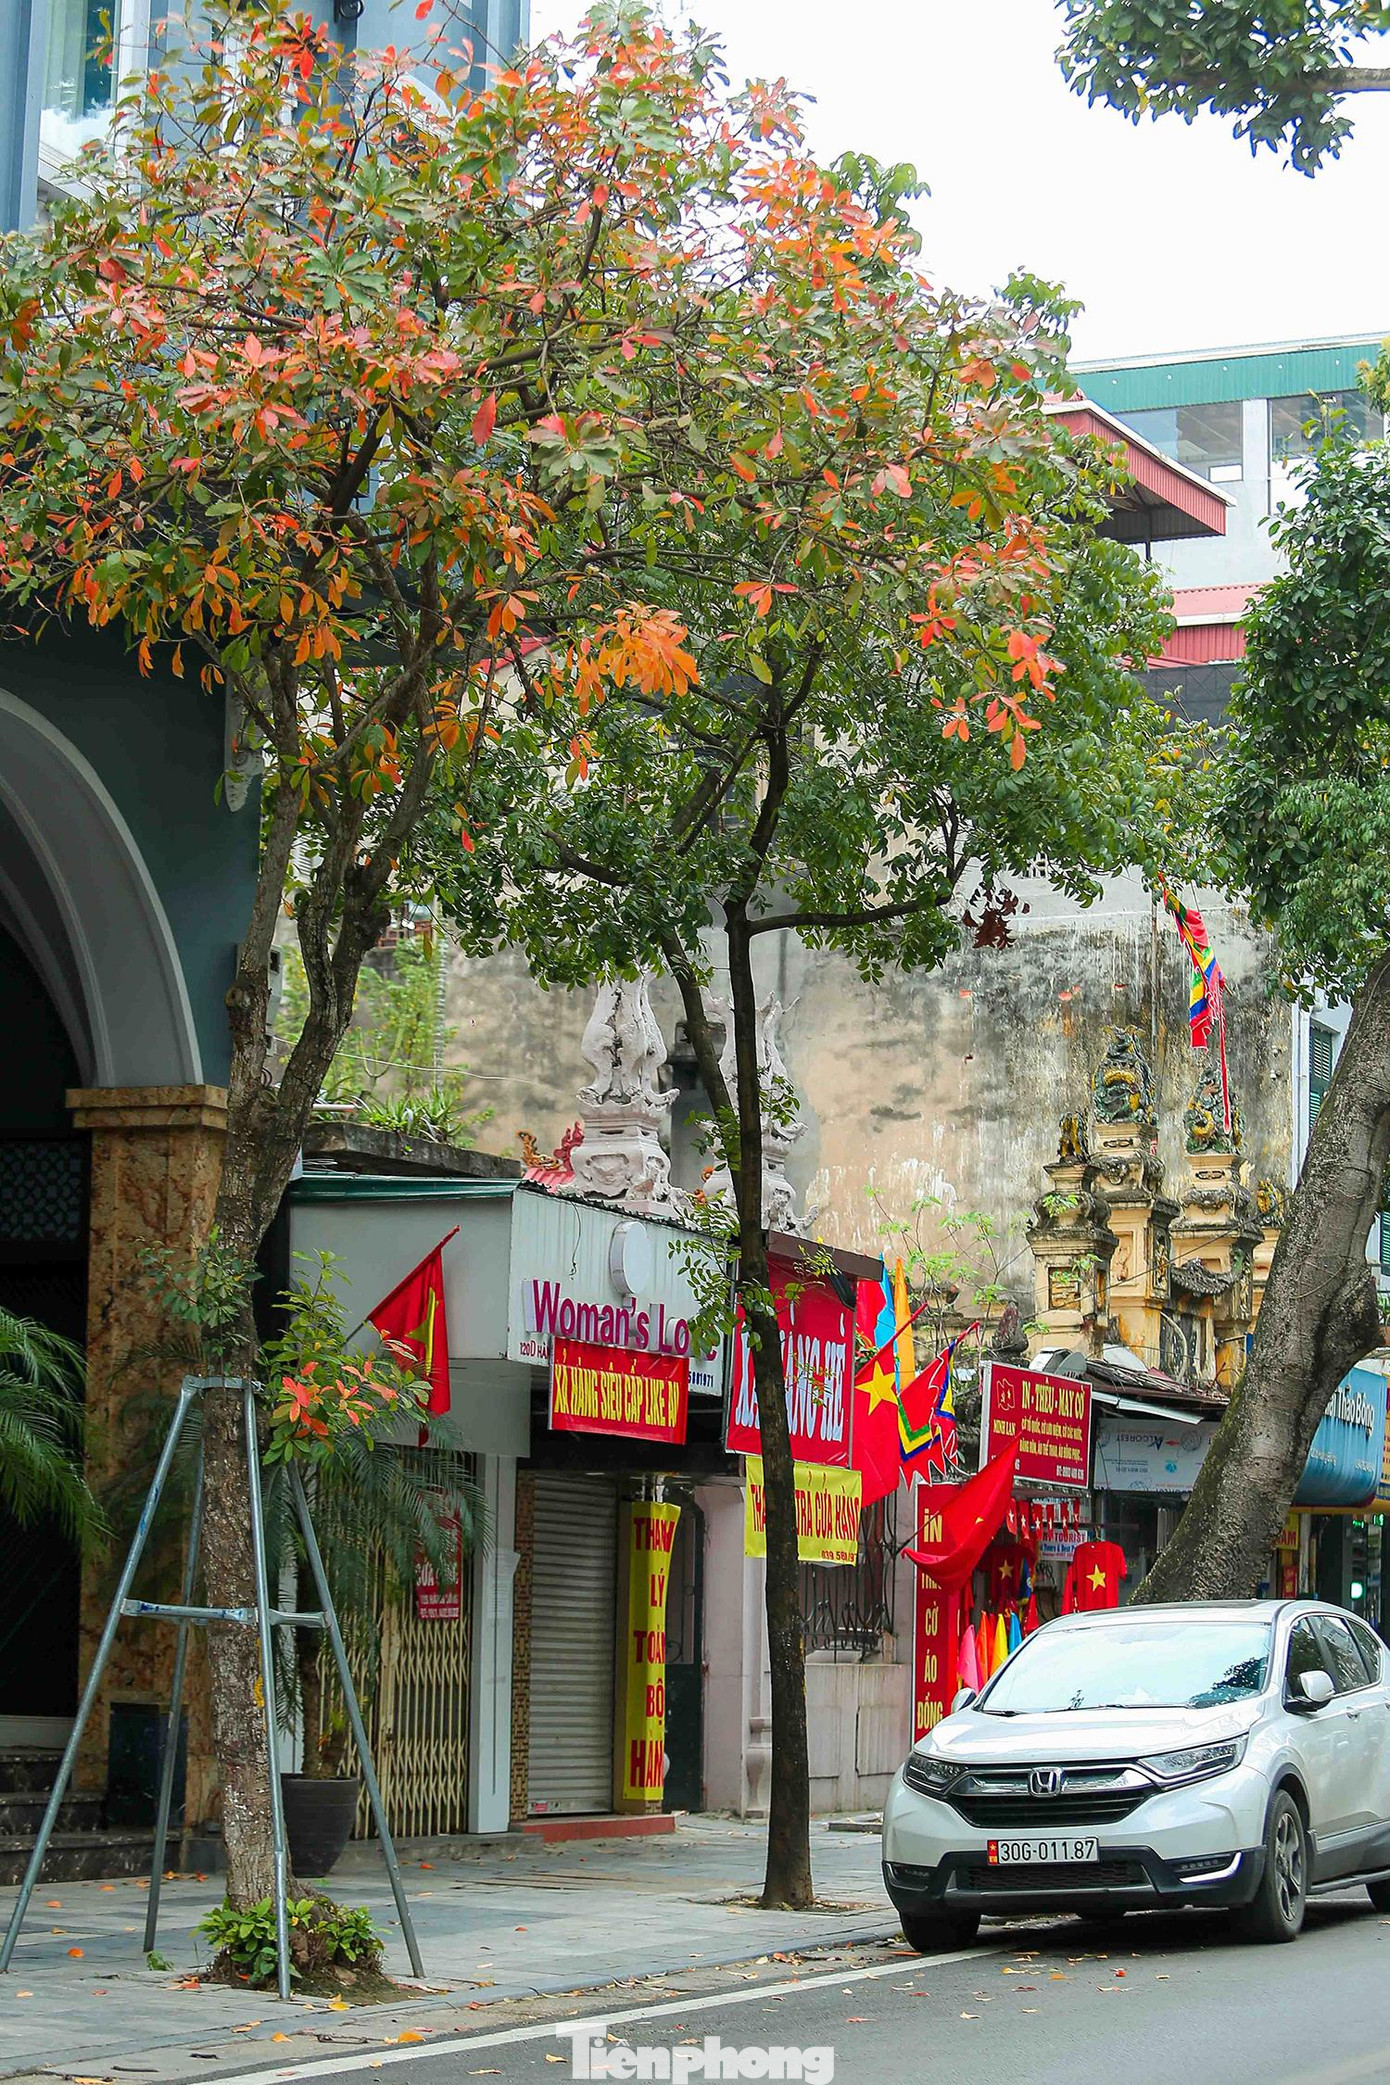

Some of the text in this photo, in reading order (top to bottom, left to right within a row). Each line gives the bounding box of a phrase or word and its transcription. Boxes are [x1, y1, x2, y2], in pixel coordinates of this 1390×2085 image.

[533, 1279, 650, 1350] Woman's
[554, 1348, 570, 1414] XẢ
[570, 1356, 599, 1418] HÀNG
[600, 1361, 622, 1422] SIÊU
[645, 1376, 666, 1427] LIKE
[779, 1300, 820, 1439] ÀNG
[1021, 1380, 1031, 1410] IN
[1035, 1376, 1055, 1415] THÊU
[1058, 1387, 1075, 1418] MAY
[1006, 1421, 1017, 1437] LAN
[1116, 1434, 1164, 1451] ALCOREST
[795, 1470, 813, 1537] TRẢ
[815, 1472, 832, 1539] CỬA
[650, 1567, 665, 1608] LÝ
[925, 1601, 939, 1637] CỜ
[924, 1649, 937, 1684] ÁO
[646, 1677, 664, 1726] BỘ
[917, 1692, 943, 1730] ĐỒNG
[1000, 1840, 1095, 1861] 30G-011.87
